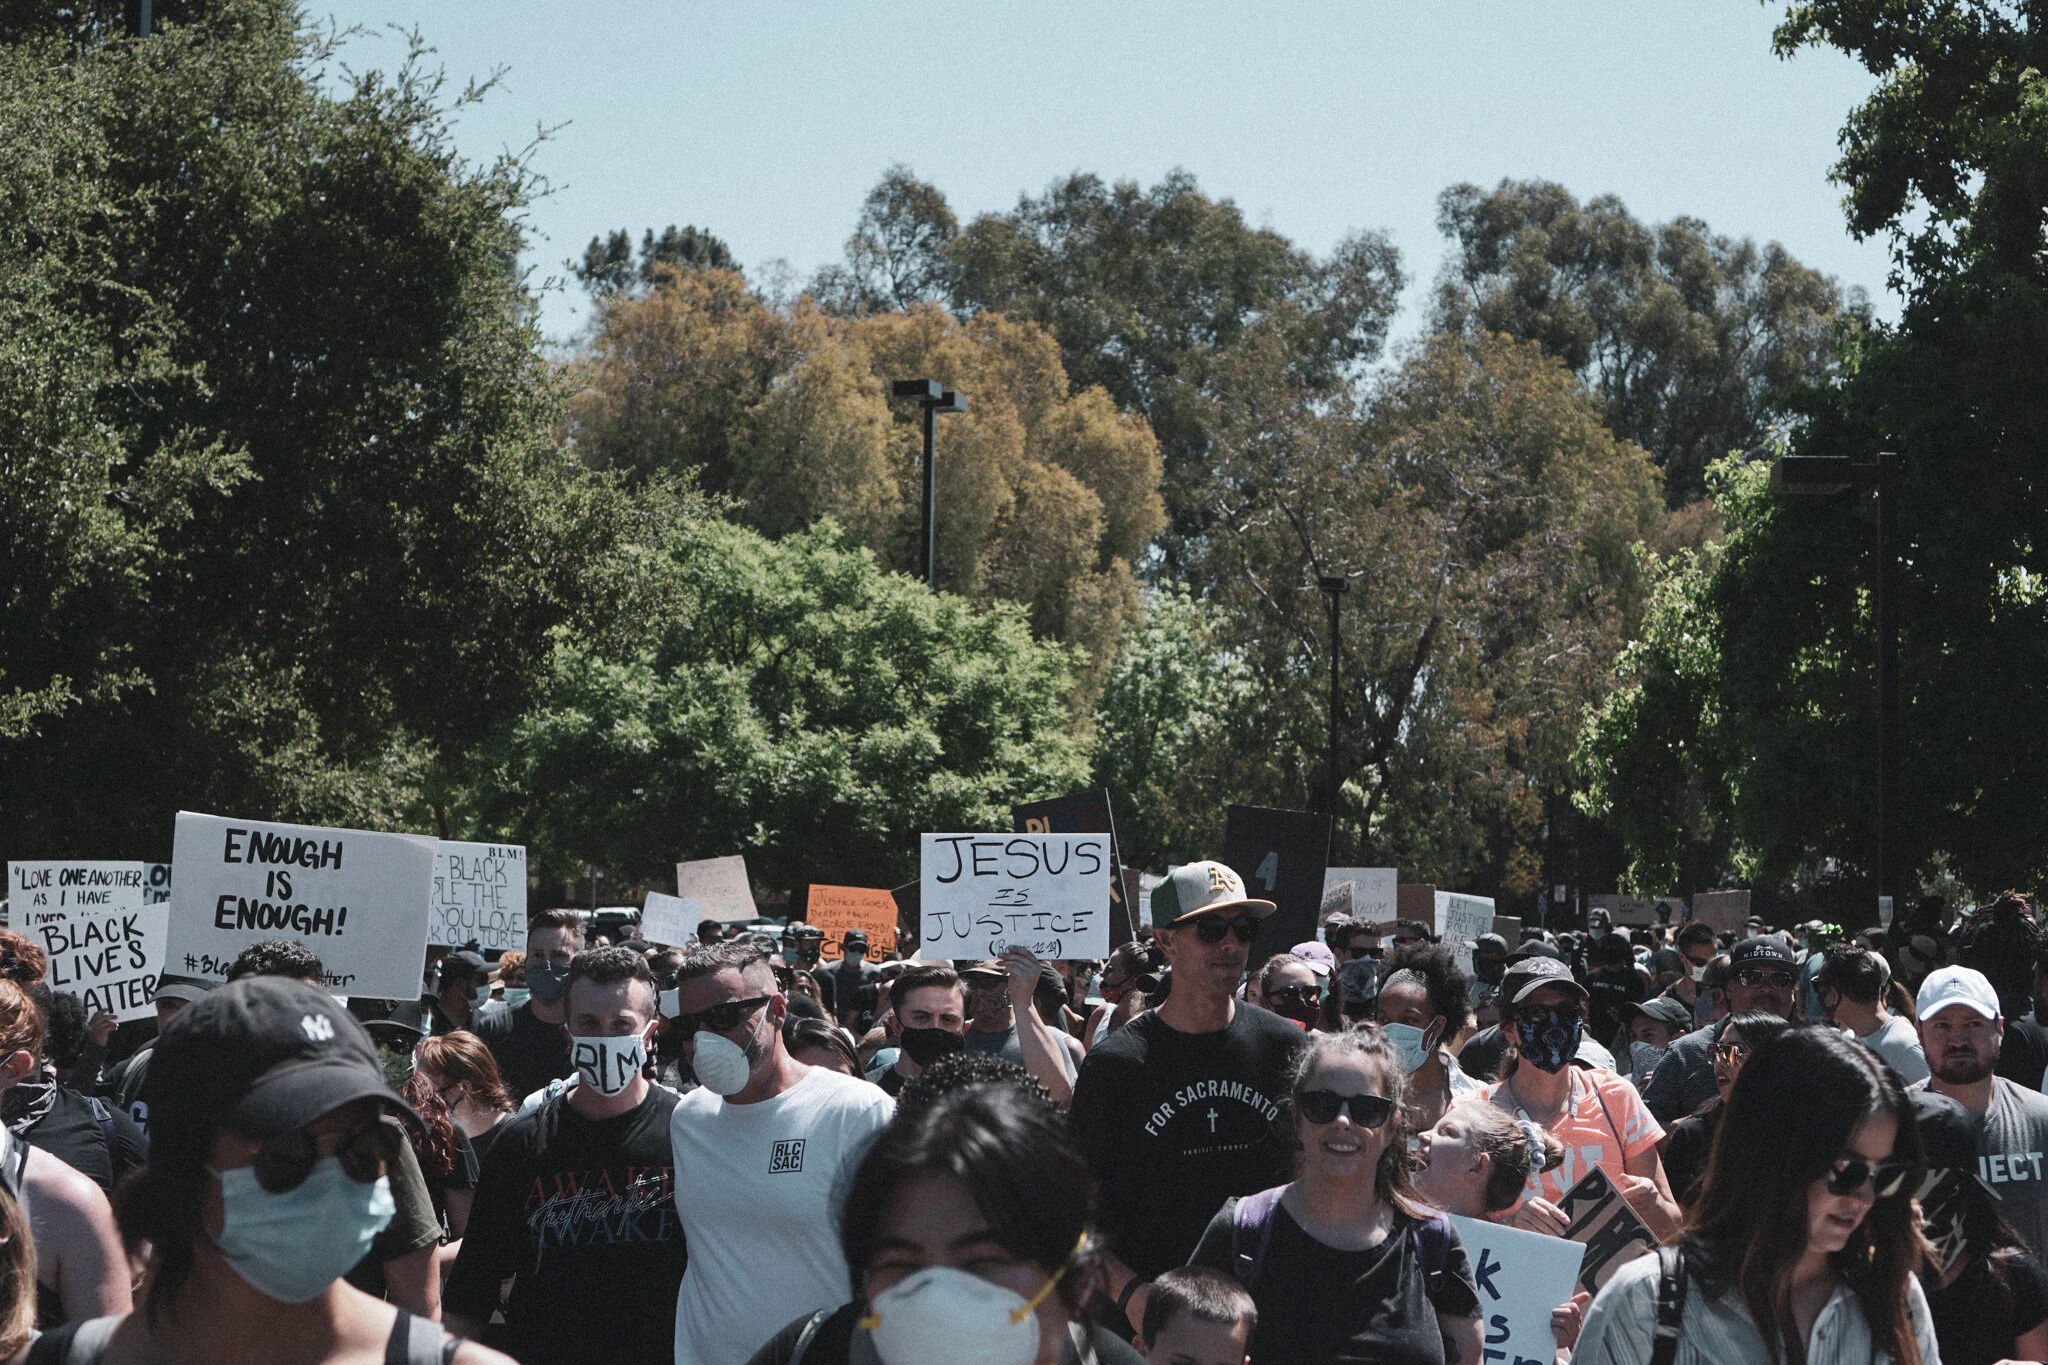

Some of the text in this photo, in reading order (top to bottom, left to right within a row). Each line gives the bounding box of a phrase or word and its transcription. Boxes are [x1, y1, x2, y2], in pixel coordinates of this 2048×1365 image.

[224, 828, 343, 869] ENOUGH
[489, 847, 523, 860] BLM!
[934, 836, 1101, 883] JESUS
[59, 868, 87, 886] ONE
[87, 869, 142, 888] ANOTHER
[449, 855, 507, 884] BLACK
[33, 890, 113, 906] AS I HAVE
[266, 870, 293, 900] IS
[467, 883, 508, 909] THE
[995, 888, 1030, 904] IS
[215, 895, 347, 936] ENOUGH!
[1450, 899, 1468, 910] LET
[436, 907, 525, 934] YOU LOVE
[926, 911, 1093, 942] JUSTICE
[1446, 920, 1472, 935] ROLL
[1448, 910, 1488, 927] JUSTICE
[39, 913, 144, 955] BLACK
[447, 927, 523, 949] CULTURE
[52, 940, 146, 986] LIVES
[70, 974, 157, 1017] ATTER
[1144, 1080, 1278, 1136] FOR SACRAMENTO
[775, 1142, 801, 1157] RLC
[773, 1156, 800, 1170] SAC
